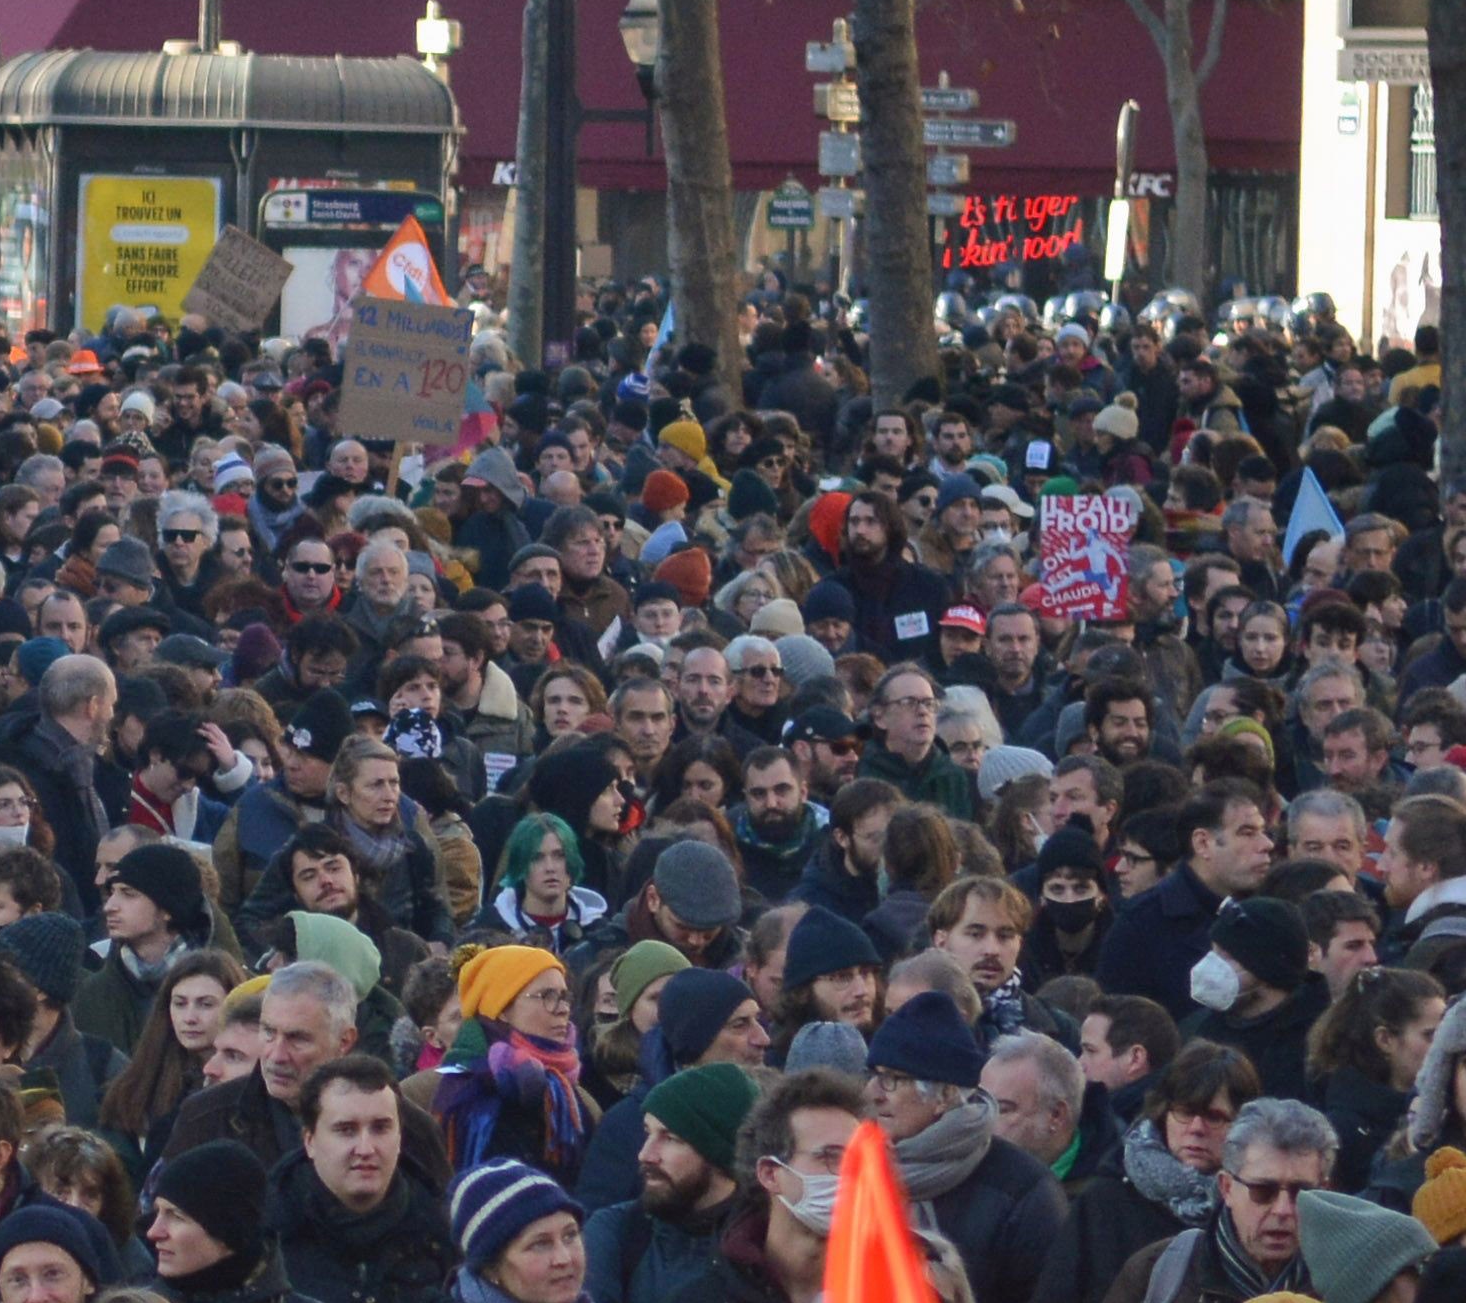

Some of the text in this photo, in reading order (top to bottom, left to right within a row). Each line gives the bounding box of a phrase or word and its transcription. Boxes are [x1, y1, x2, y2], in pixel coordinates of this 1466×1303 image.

[116, 206, 182, 220] TROUVEZ UN
[312, 199, 359, 210] Strasbourg
[117, 247, 179, 261] SANS FAIRE
[130, 263, 179, 278] MOINDRE
[1041, 495, 1133, 514] IL FAIT
[1040, 509, 1130, 534] FROID
[1043, 548, 1071, 572] ON
[1041, 581, 1101, 608] CHAUDS
